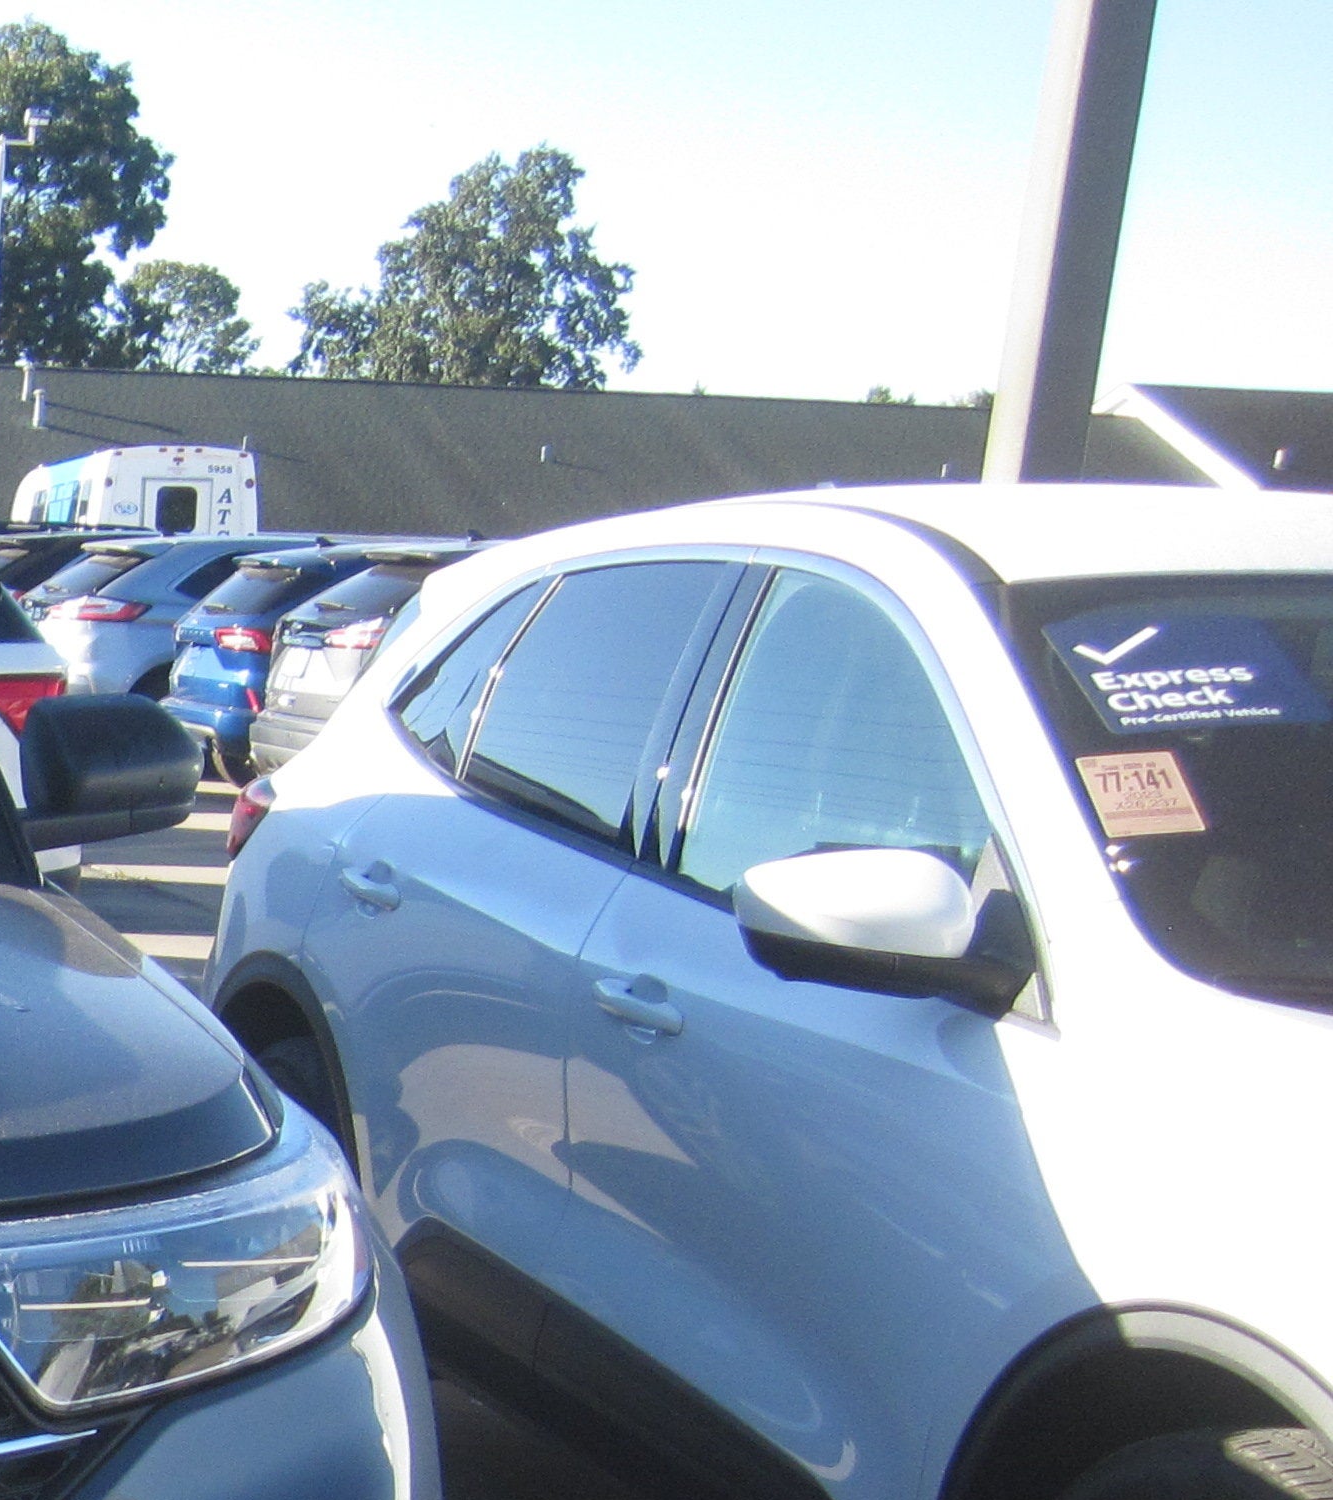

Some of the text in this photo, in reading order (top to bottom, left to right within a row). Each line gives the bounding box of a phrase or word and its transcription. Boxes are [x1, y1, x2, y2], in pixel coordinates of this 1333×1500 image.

[1090, 666, 1254, 691] Express
[1107, 685, 1235, 712] Check
[1118, 706, 1281, 726] Pre-Certified Vehicle
